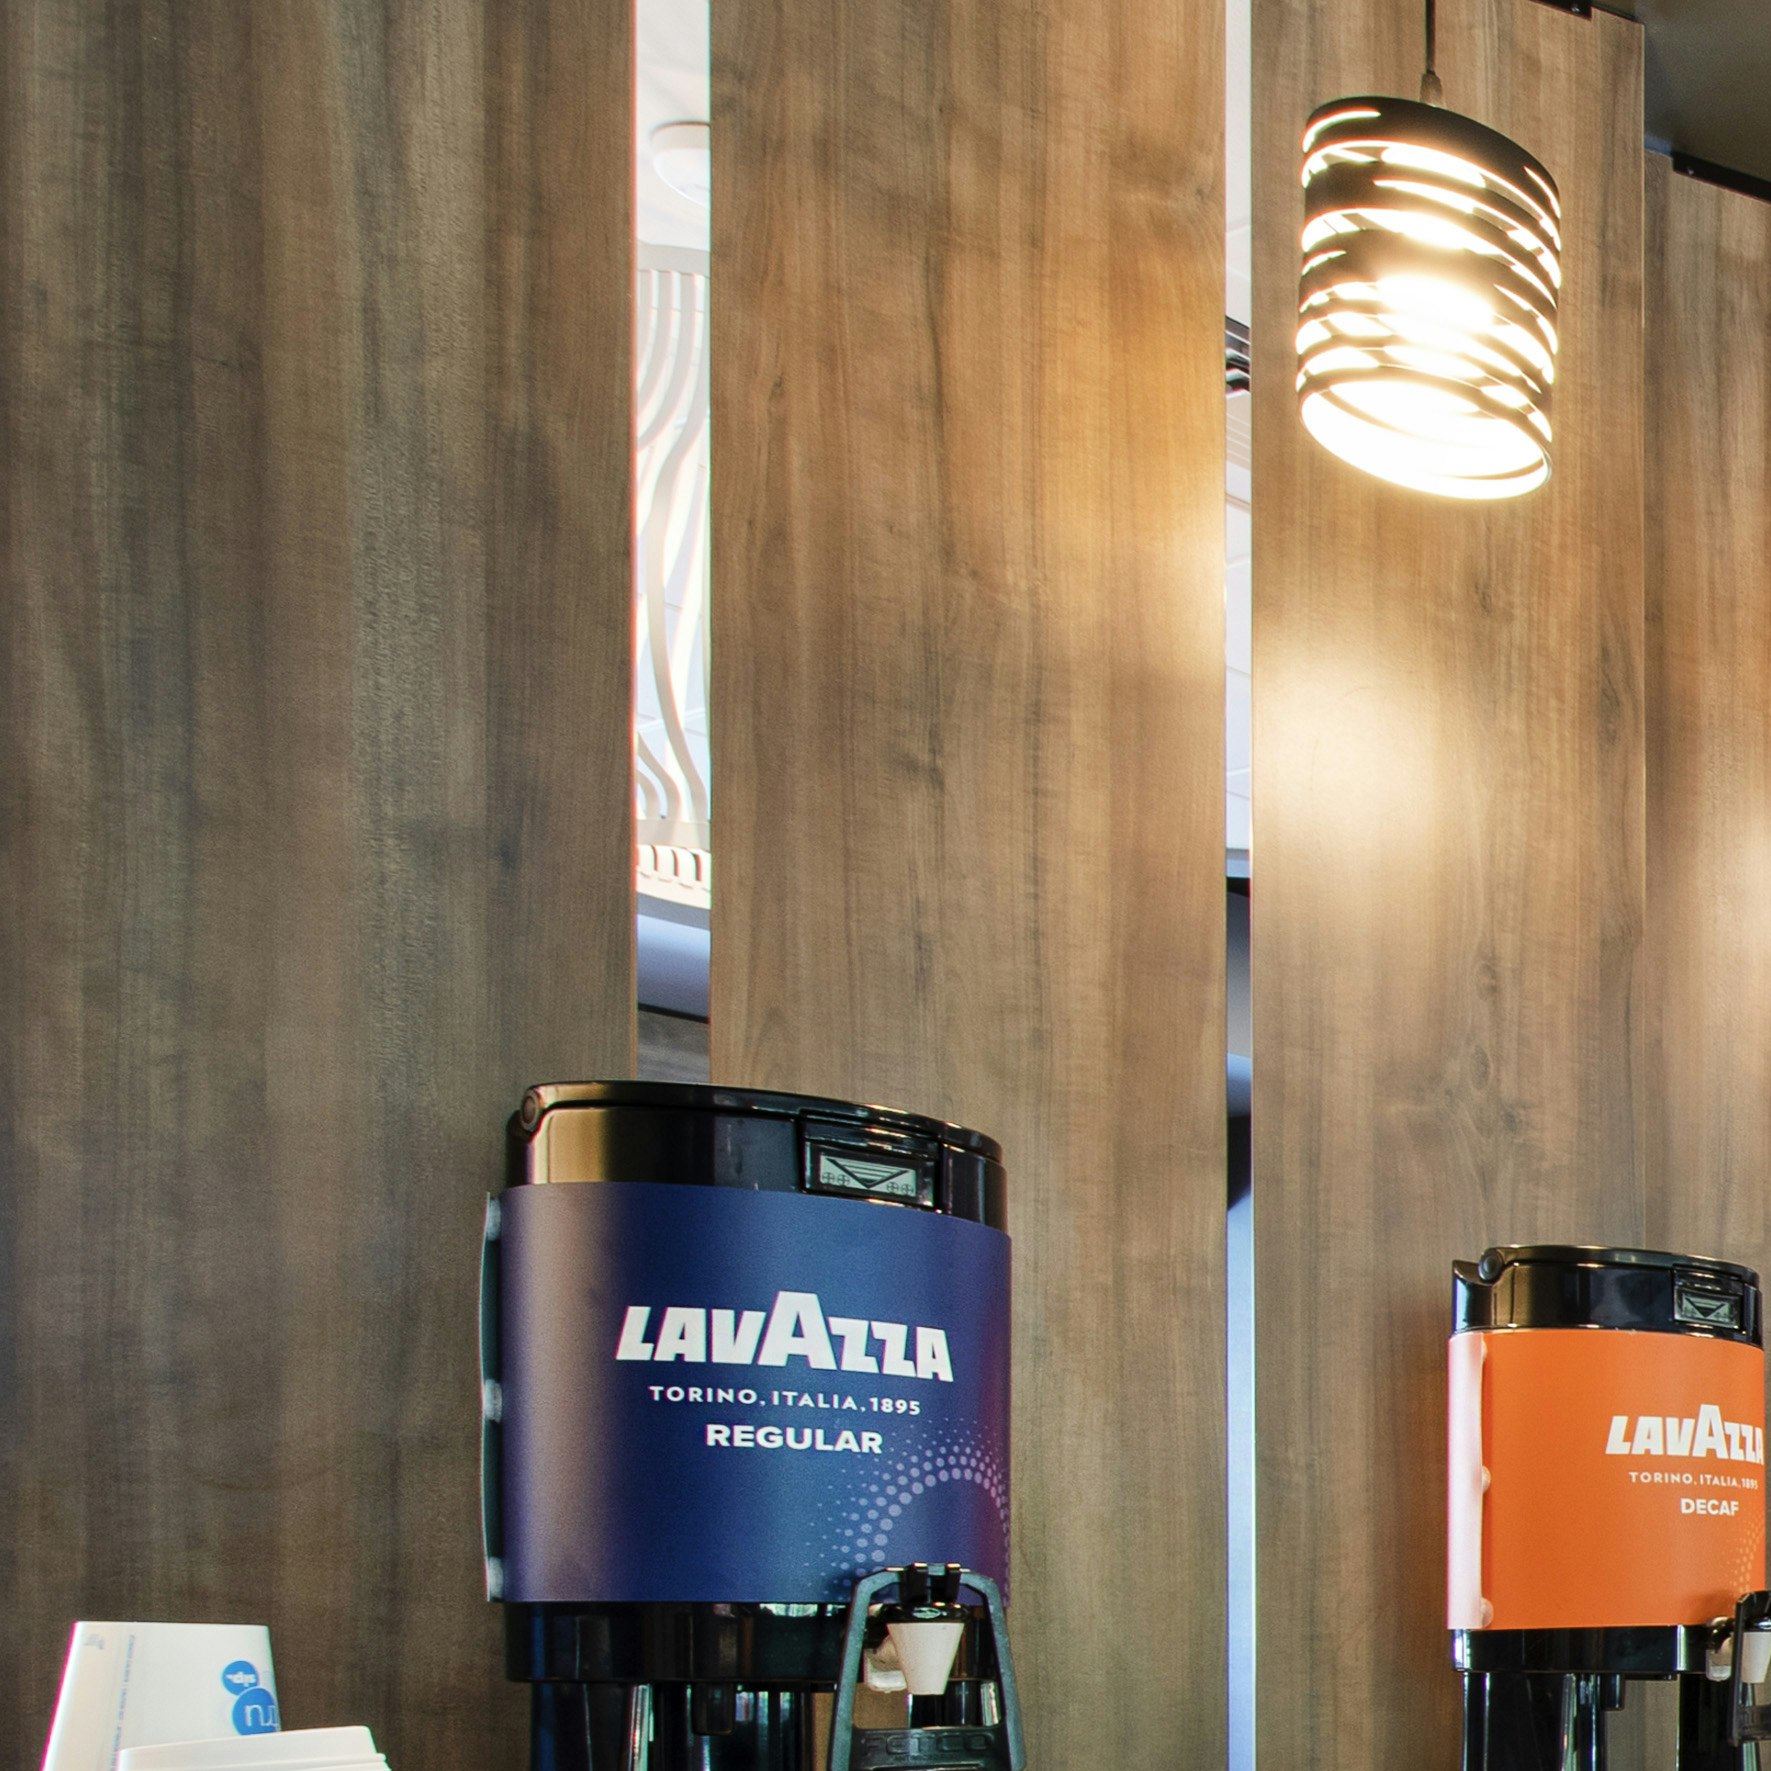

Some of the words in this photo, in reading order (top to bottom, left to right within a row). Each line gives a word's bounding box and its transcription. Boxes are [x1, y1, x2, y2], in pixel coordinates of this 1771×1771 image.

[614, 1290, 954, 1382] LAVAZZA
[649, 1385, 766, 1406] TORINO,
[772, 1390, 866, 1412] ITALIA,
[869, 1397, 921, 1416] 1895
[706, 1423, 883, 1454] REGULAR
[1605, 1403, 1764, 1466] LAVAZZA
[1628, 1471, 1698, 1485] TORINO,
[1680, 1498, 1739, 1516] DECAF
